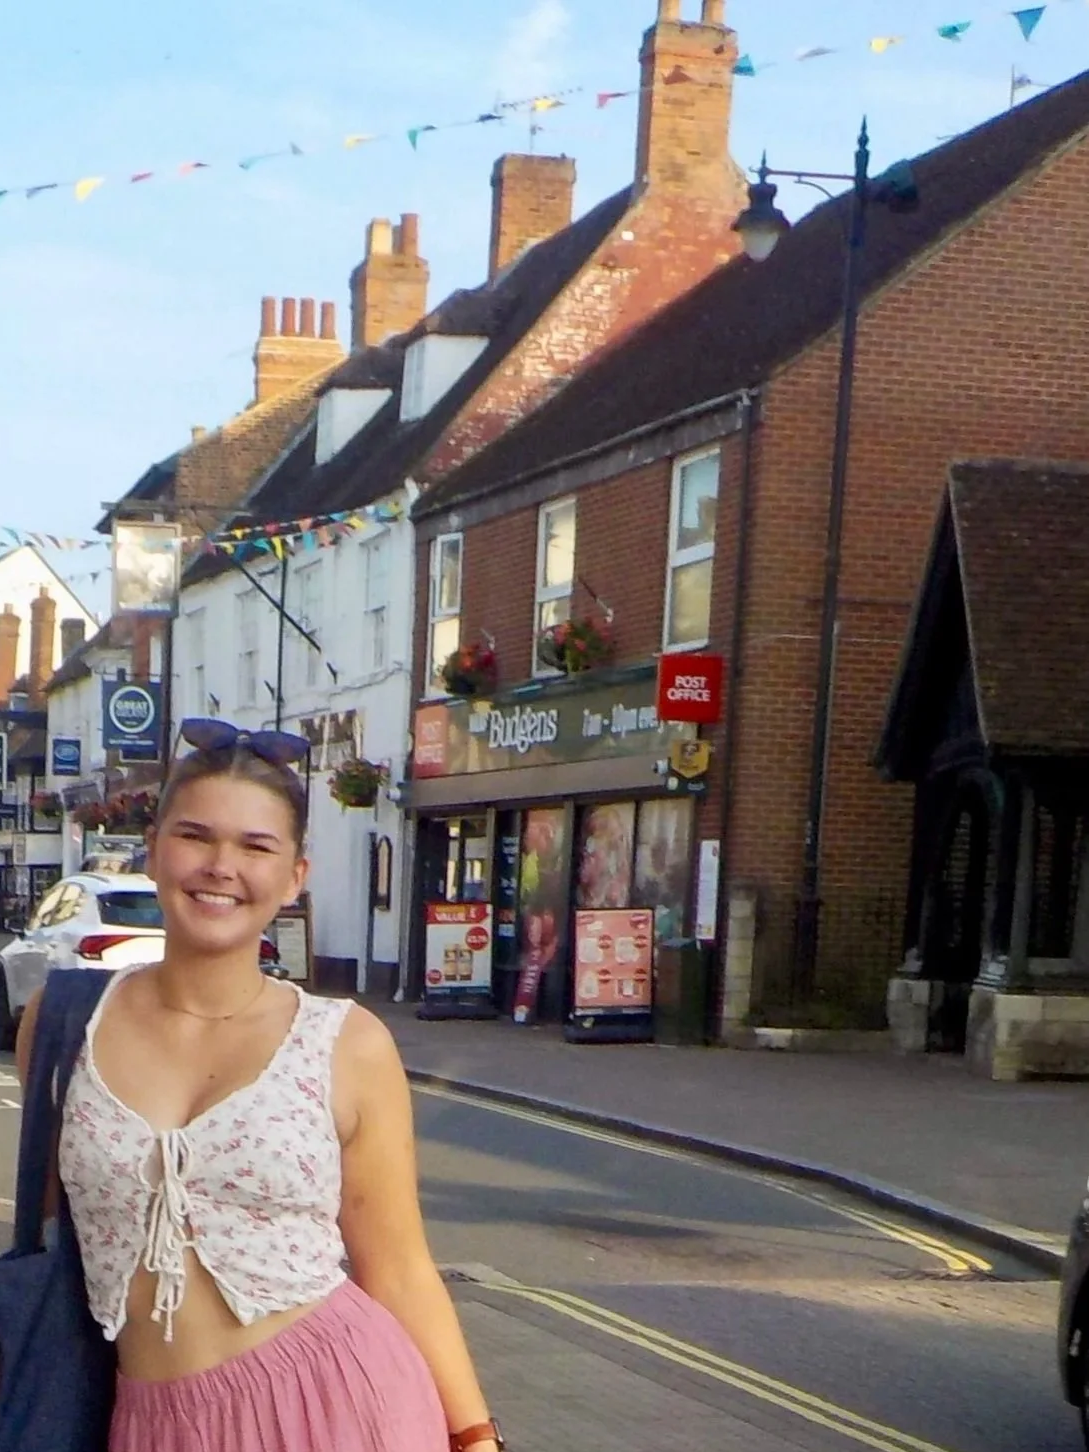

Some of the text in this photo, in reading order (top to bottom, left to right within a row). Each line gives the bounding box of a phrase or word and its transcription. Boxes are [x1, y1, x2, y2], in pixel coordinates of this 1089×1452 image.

[674, 675, 708, 689] POST
[667, 687, 711, 702] OFFICE
[488, 705, 559, 753] Budgens
